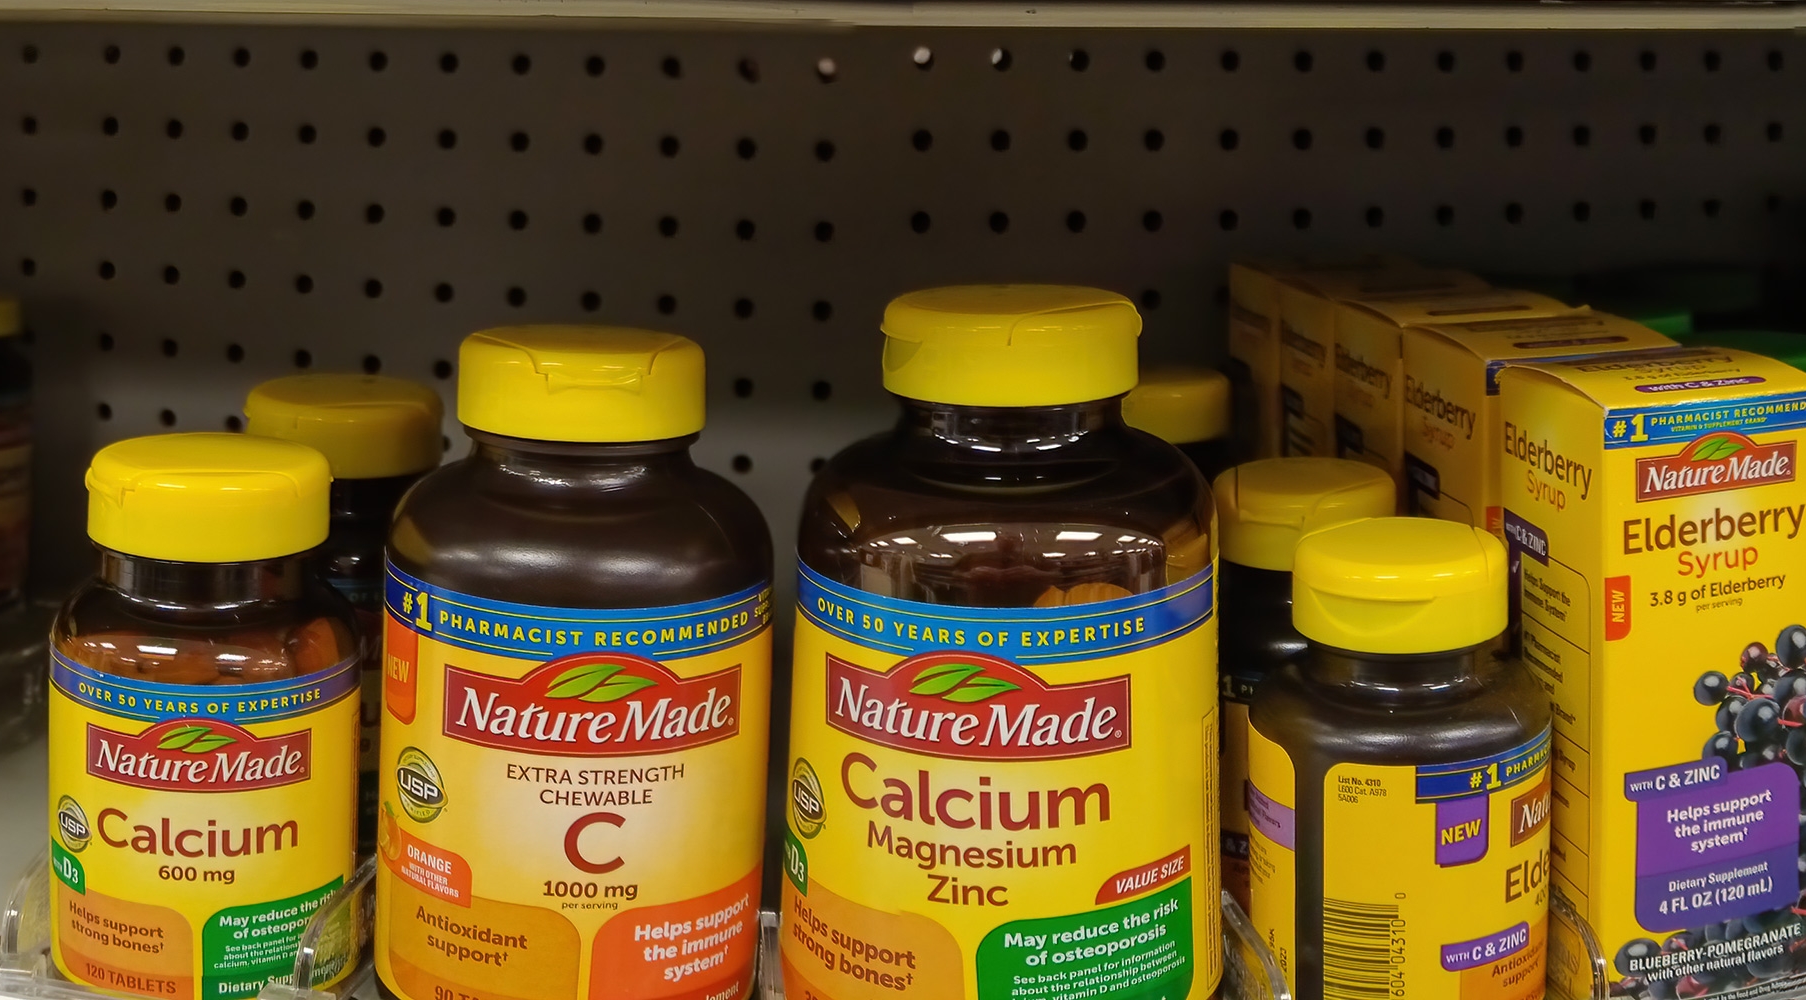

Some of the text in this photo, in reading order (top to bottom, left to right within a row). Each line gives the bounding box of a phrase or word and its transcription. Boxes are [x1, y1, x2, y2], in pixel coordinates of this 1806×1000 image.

[1624, 504, 1805, 555] Elderberry
[1678, 544, 1758, 578] Syrup
[818, 598, 1145, 647] OVER 50 YEARS OF EXPERTISE
[1613, 590, 1625, 623] NEW
[440, 613, 748, 646] PHARMACIST RECOMMENDED
[507, 764, 685, 784] EXTRA STRENGTH
[841, 752, 1110, 832] Calcium
[540, 790, 653, 806] CHEWABLE
[97, 808, 298, 858] Calcium
[564, 812, 626, 874] C
[867, 821, 1077, 870] Magnesium
[1441, 820, 1480, 845] NEW
[158, 866, 235, 884] 600 mg
[543, 881, 638, 900] 1000 mg
[927, 875, 1009, 907] Zinc
[1116, 856, 1184, 895] VALUE SIZE
[1659, 878, 1773, 915] 4 FL OZ (120 mL)
[1004, 899, 1179, 950] May reduce the risk
[1025, 924, 1166, 966] of osteoporosis
[1629, 924, 1801, 972] BLUEBERRY-POMEGRANATE
